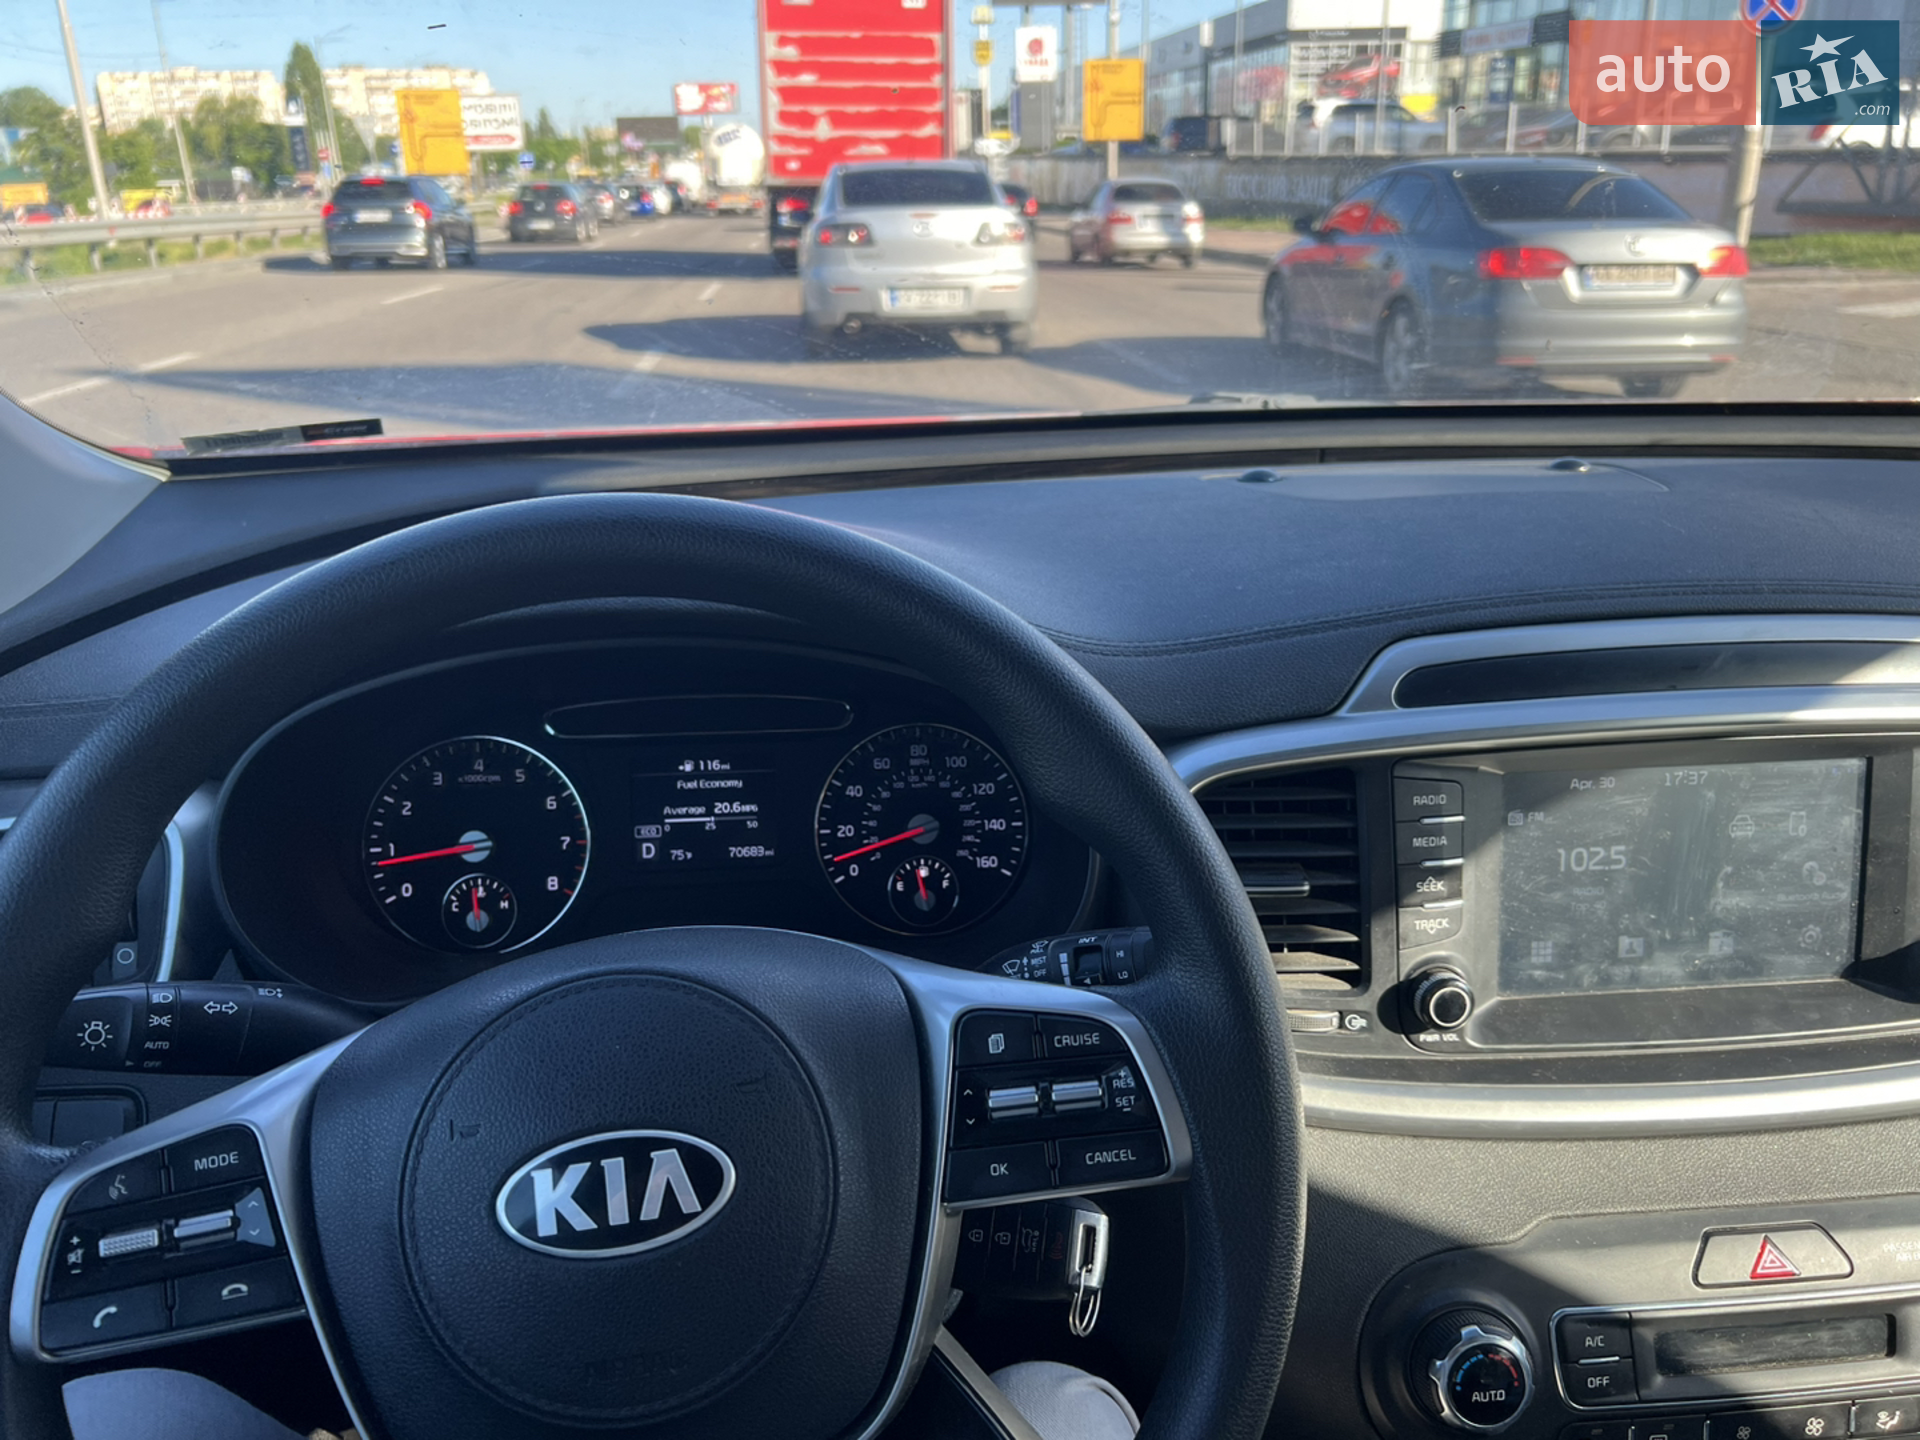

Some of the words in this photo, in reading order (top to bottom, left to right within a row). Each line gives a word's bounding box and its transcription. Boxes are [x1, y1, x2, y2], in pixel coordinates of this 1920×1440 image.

[910, 744, 928, 757] 80
[474, 759, 485, 772] 4
[873, 757, 891, 770] 60
[909, 758, 930, 767] MPH
[945, 756, 968, 768] 100
[433, 772, 443, 786] 3
[515, 769, 526, 784] 5
[1664, 770, 1708, 786] 17:37
[677, 779, 698, 789] Fuel
[700, 778, 743, 789] Economy
[973, 783, 995, 796] 120
[1570, 777, 1595, 791] Apr.
[1600, 776, 1616, 789] 30
[845, 785, 863, 798] 40
[546, 797, 557, 810] 6
[1413, 794, 1447, 806] RADIO
[402, 802, 412, 816] 2
[663, 806, 706, 816] Average
[1527, 812, 1545, 824] FM
[664, 825, 671, 833] 0
[705, 822, 717, 831] 25
[746, 821, 758, 829] 50
[837, 825, 855, 838] 20
[984, 819, 1006, 831] 140
[640, 828, 657, 836] ECO
[560, 836, 571, 850] 7
[1413, 835, 1448, 848] MEDIA
[389, 843, 395, 856] 1
[642, 843, 656, 859] D
[976, 856, 998, 869] 160
[1557, 845, 1628, 872] 102.5
[849, 864, 859, 877] 0
[402, 883, 413, 897] 0
[547, 877, 558, 891] 8
[896, 881, 904, 892] E
[942, 879, 950, 890] F
[1416, 880, 1445, 893] SEEK
[451, 901, 460, 912] C
[500, 900, 509, 910] H
[1414, 918, 1450, 931] TRACK
[1078, 936, 1098, 944] INT
[1116, 950, 1125, 958] HI
[1030, 956, 1047, 966] MIST
[1033, 968, 1047, 978] OFF
[1117, 970, 1129, 980] LO
[1054, 1032, 1100, 1047] CRUISE
[1442, 1033, 1461, 1042] VOL
[144, 1040, 170, 1050] AUTO
[143, 1060, 162, 1068] OFF
[1113, 1078, 1135, 1089] RES
[1115, 1095, 1135, 1107] SET
[194, 1151, 239, 1172] MODE
[1086, 1149, 1136, 1165] CANCEL
[990, 1162, 1009, 1177] OK
[530, 1148, 702, 1237] KIA
[1584, 1334, 1605, 1349] A/C
[1587, 1375, 1610, 1389] OFF
[1471, 1389, 1506, 1403] AUTO
